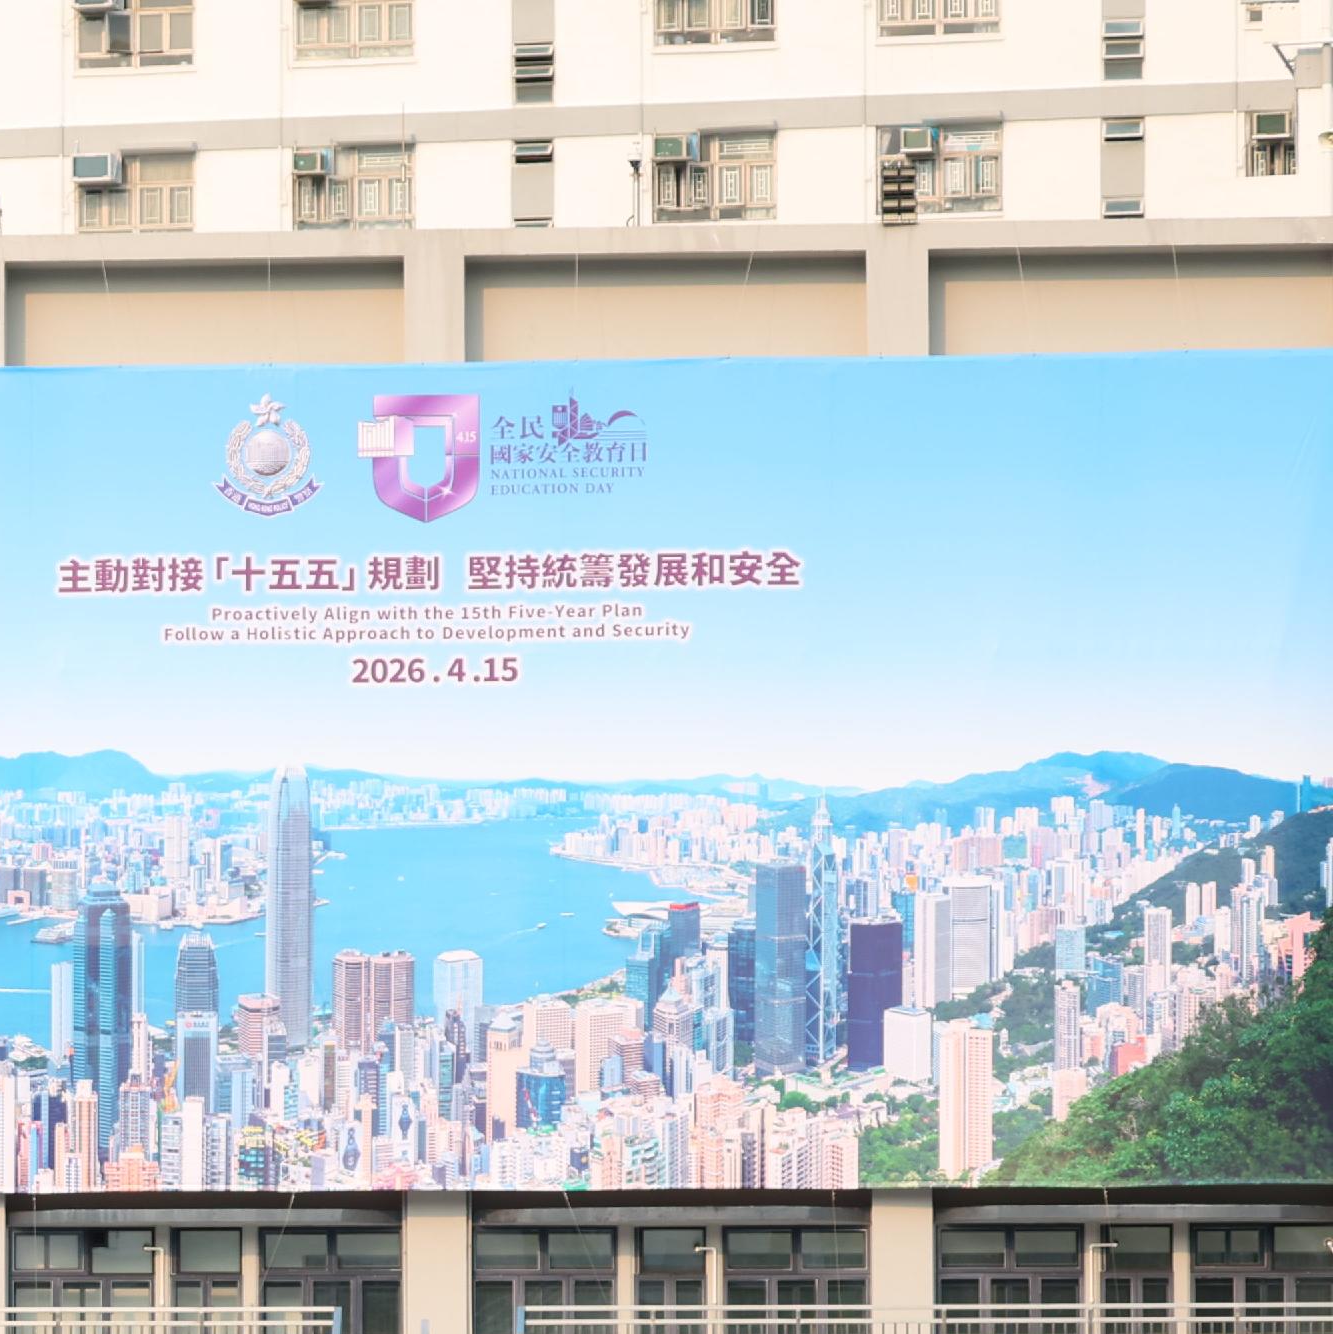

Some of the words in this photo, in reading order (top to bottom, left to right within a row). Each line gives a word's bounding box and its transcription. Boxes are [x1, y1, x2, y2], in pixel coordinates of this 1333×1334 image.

[491, 415, 544, 440] 全民
[490, 441, 648, 465] 國家安全教育日
[491, 467, 567, 480] NATIONAL
[573, 466, 645, 478] SECURITY
[491, 483, 579, 496] EDUCATION
[585, 482, 614, 494] DAY
[58, 556, 439, 592] 主動對接「十五五」規劃
[468, 551, 801, 590] 堅持統籌發展和安全
[212, 607, 318, 624] Proactively
[324, 606, 371, 623] Align
[377, 606, 418, 620] with
[424, 606, 455, 620] the
[461, 605, 502, 619] 15th
[508, 604, 596, 619] Five-Year
[603, 603, 643, 618] Plan
[164, 627, 225, 641] Follow
[231, 629, 241, 640] a
[247, 626, 317, 641] Holistic
[323, 626, 411, 643] Approach
[417, 627, 435, 640] to
[443, 625, 566, 643] Development
[572, 624, 605, 638] and
[612, 622, 691, 639] Security
